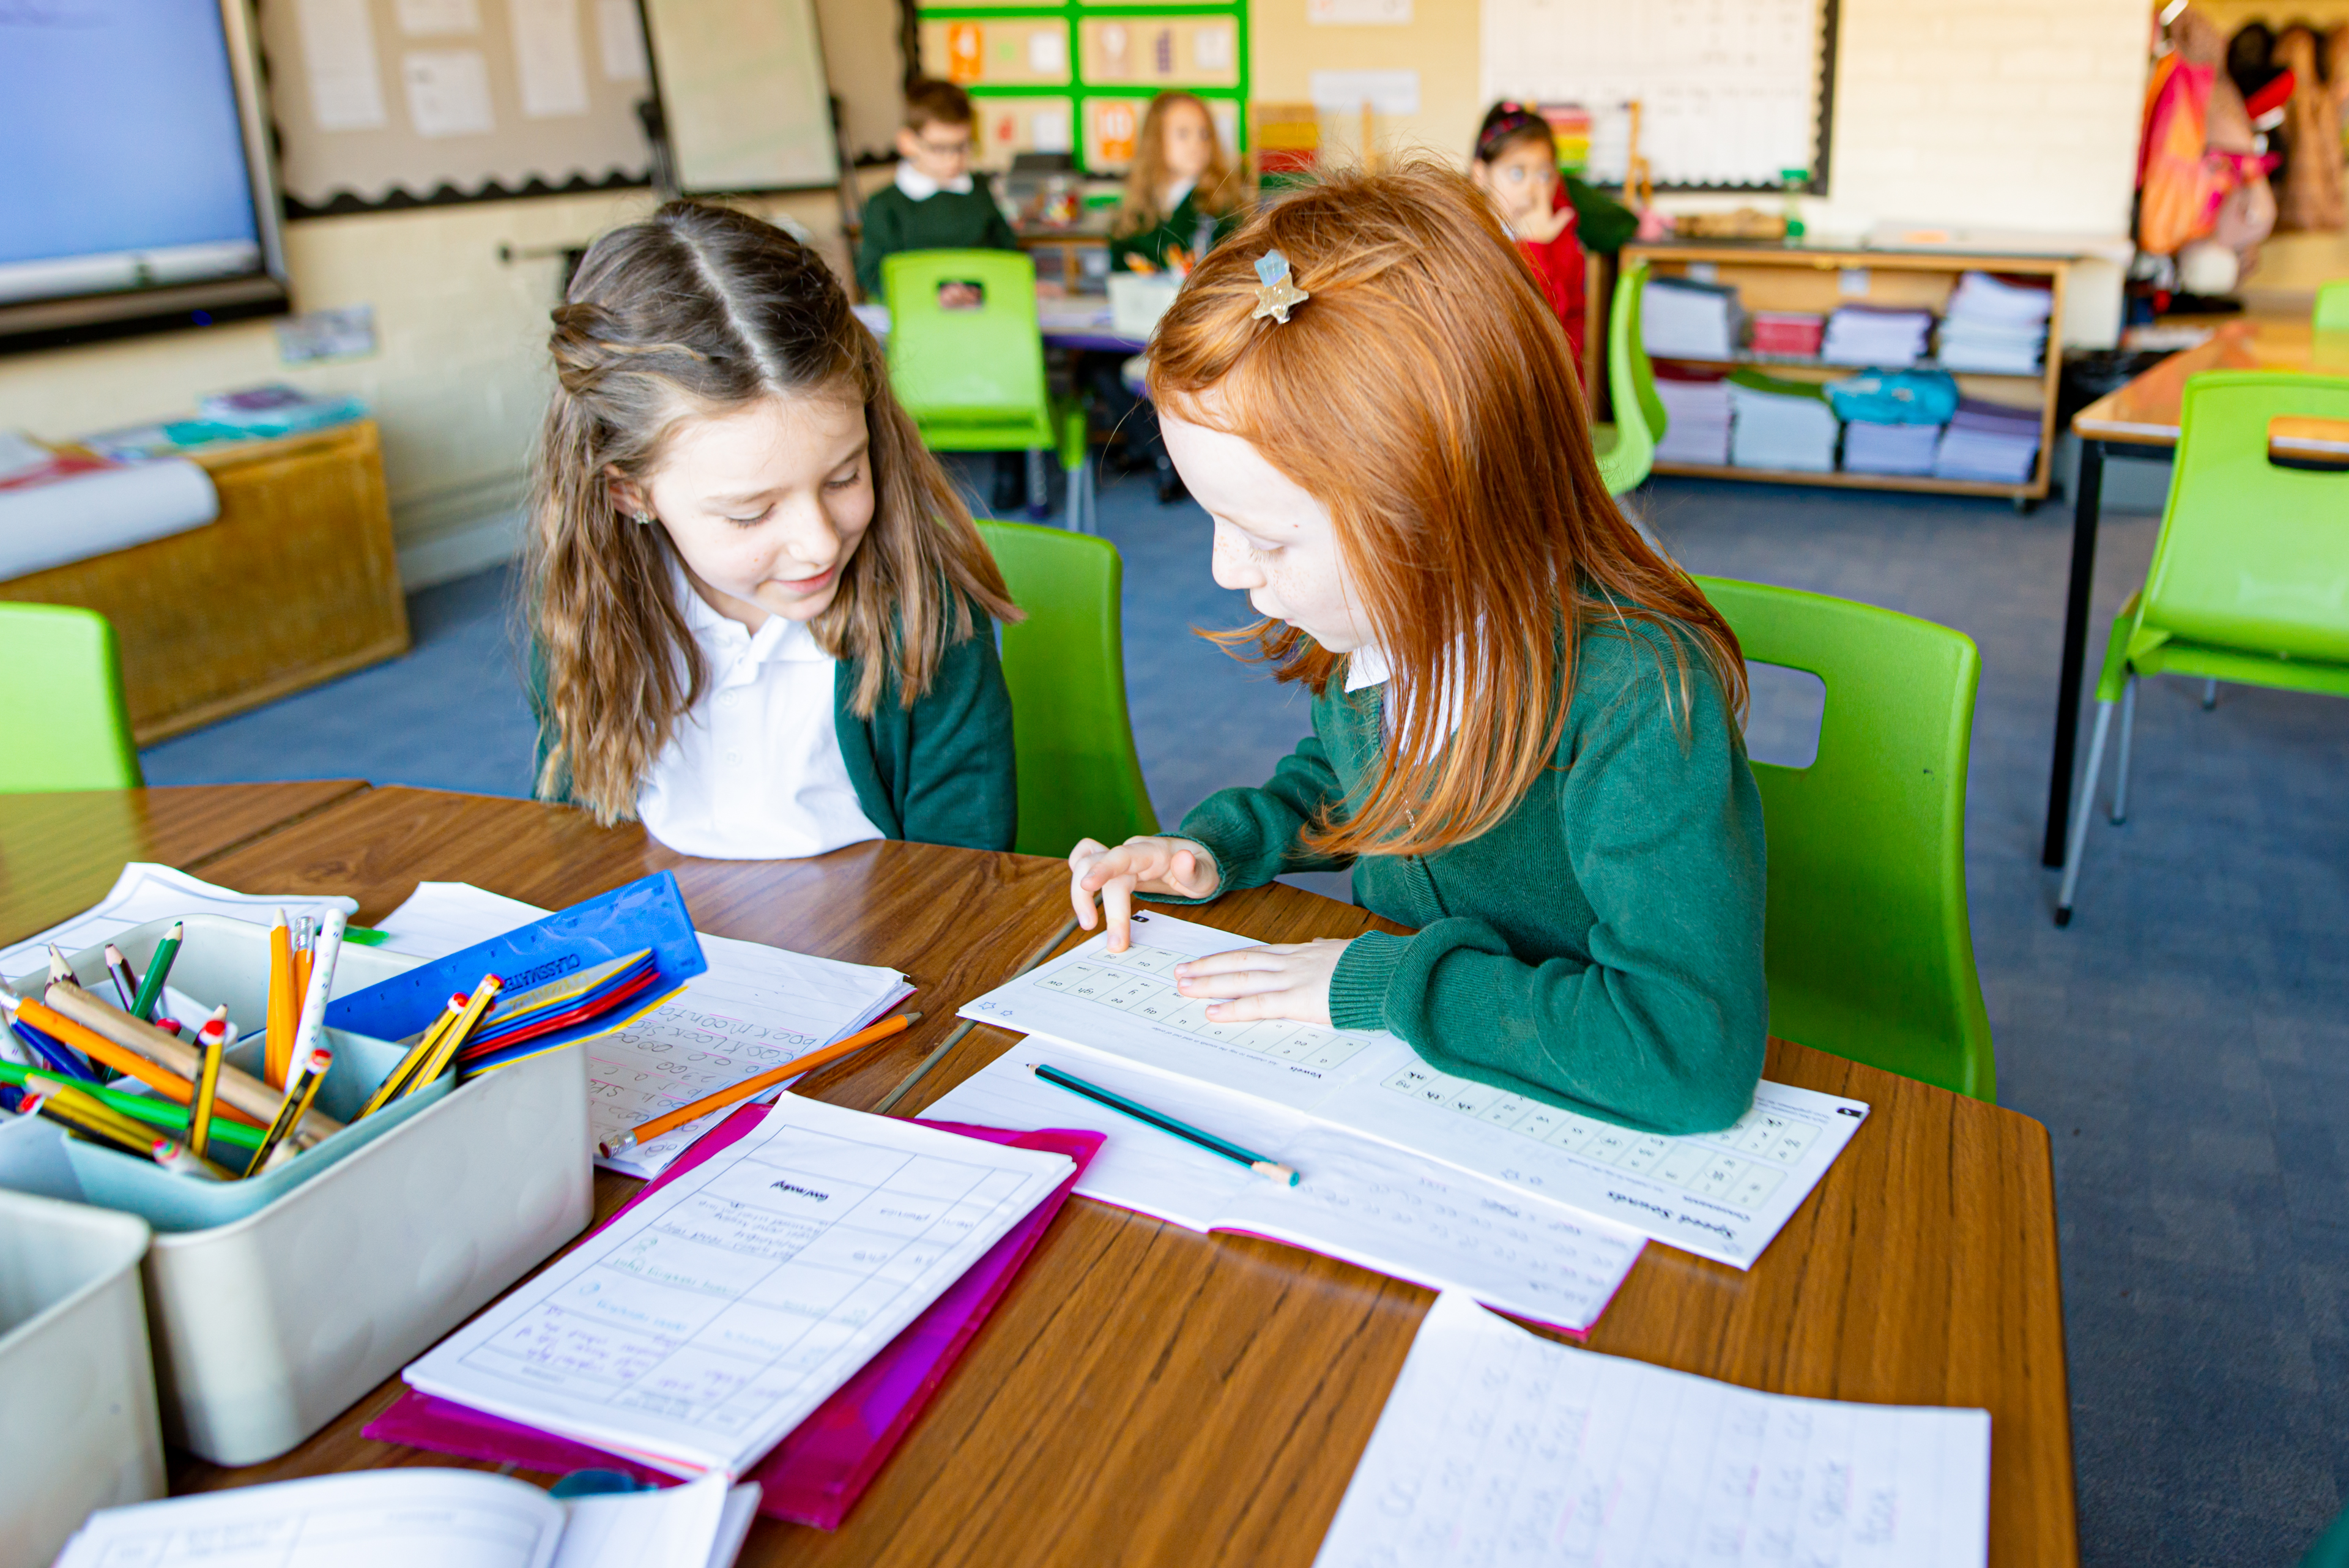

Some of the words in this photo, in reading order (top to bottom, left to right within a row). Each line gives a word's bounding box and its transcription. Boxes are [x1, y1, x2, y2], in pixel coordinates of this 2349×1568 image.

[1289, 1066, 1322, 1079] Vowels
[1608, 1191, 1674, 1219] Sounds
[1678, 1214, 1737, 1239] Speed
